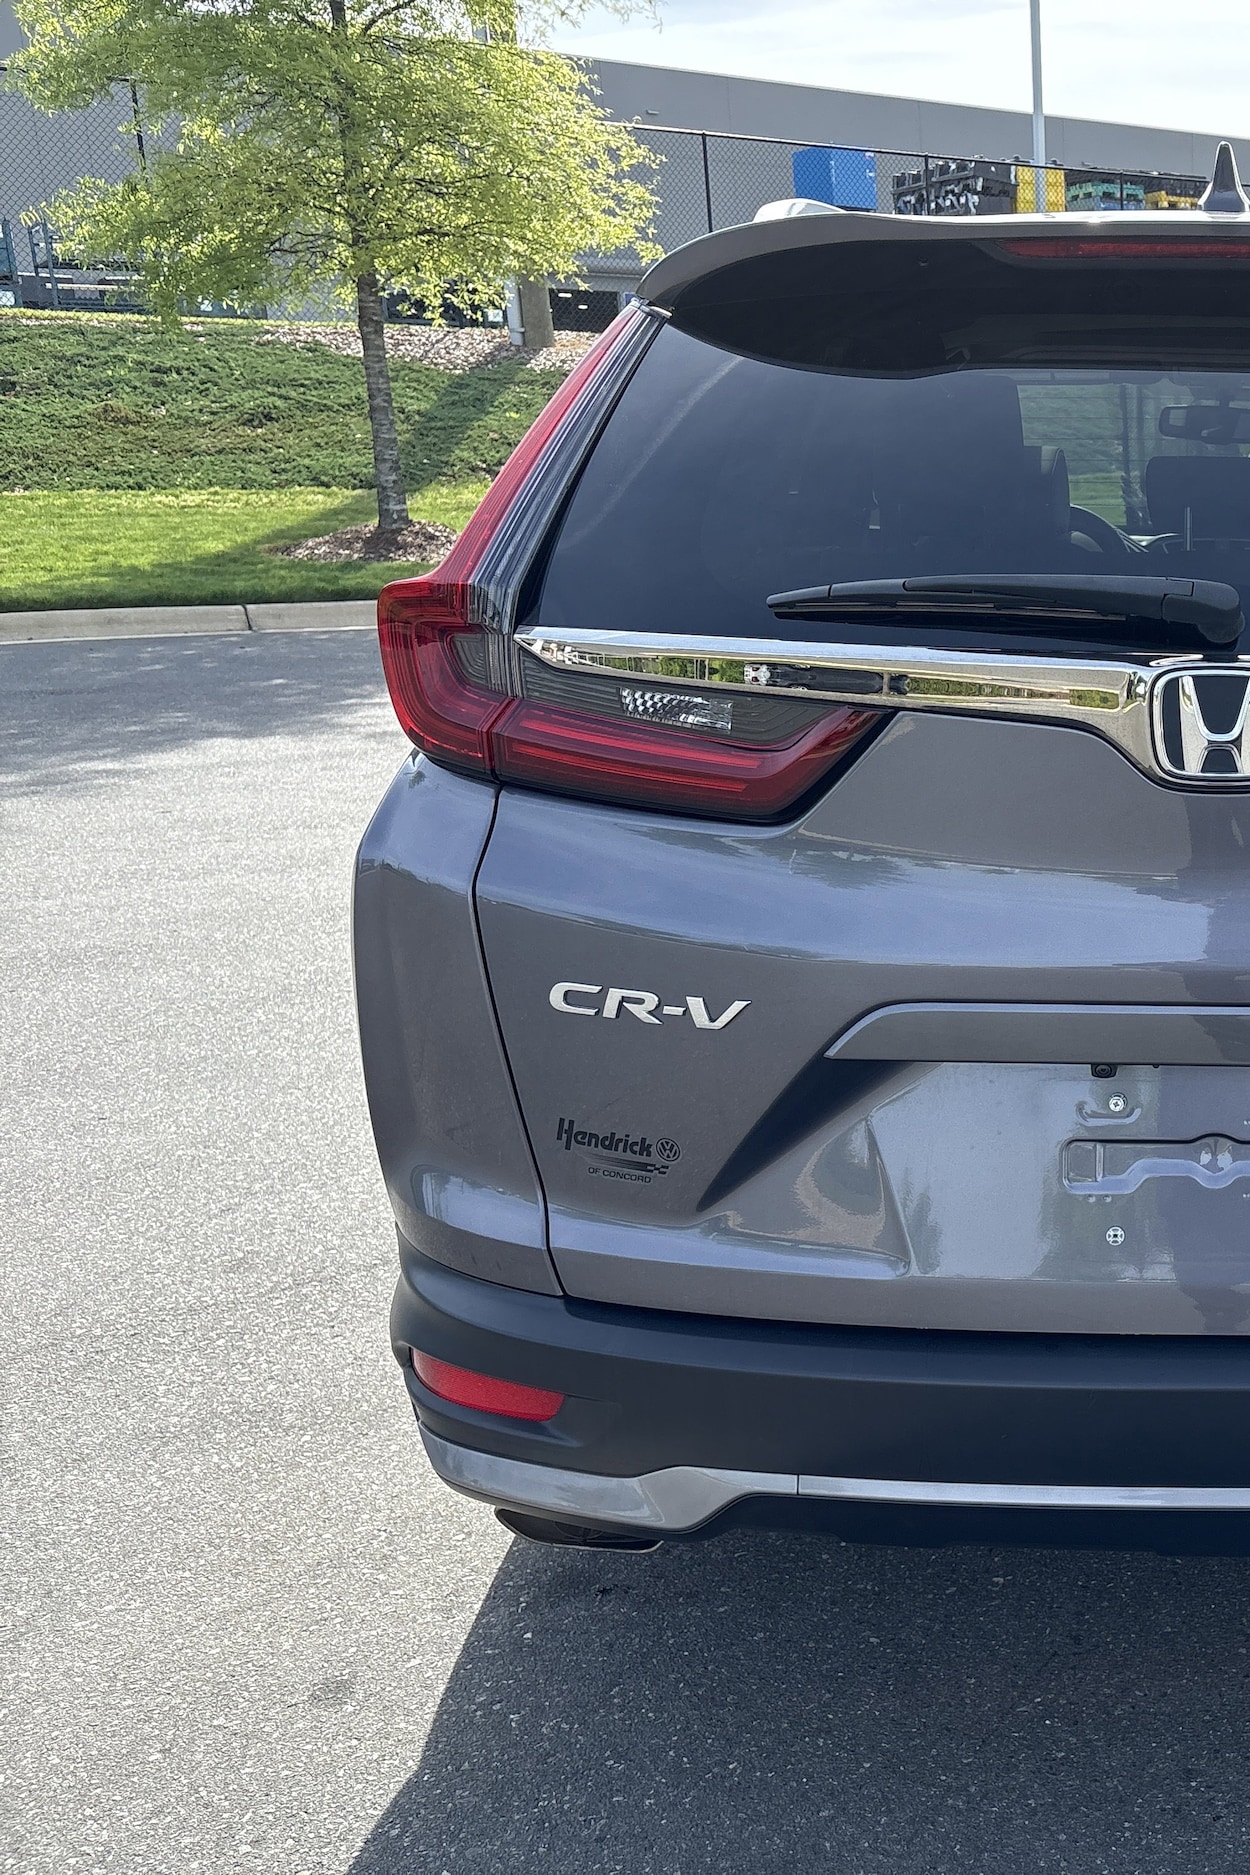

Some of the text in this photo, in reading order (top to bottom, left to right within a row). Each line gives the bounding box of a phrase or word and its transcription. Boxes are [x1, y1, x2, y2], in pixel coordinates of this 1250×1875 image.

[549, 982, 751, 1030] CR-V
[556, 1117, 653, 1157] Hendrick
[588, 1166, 652, 1184] OF CONCORD
